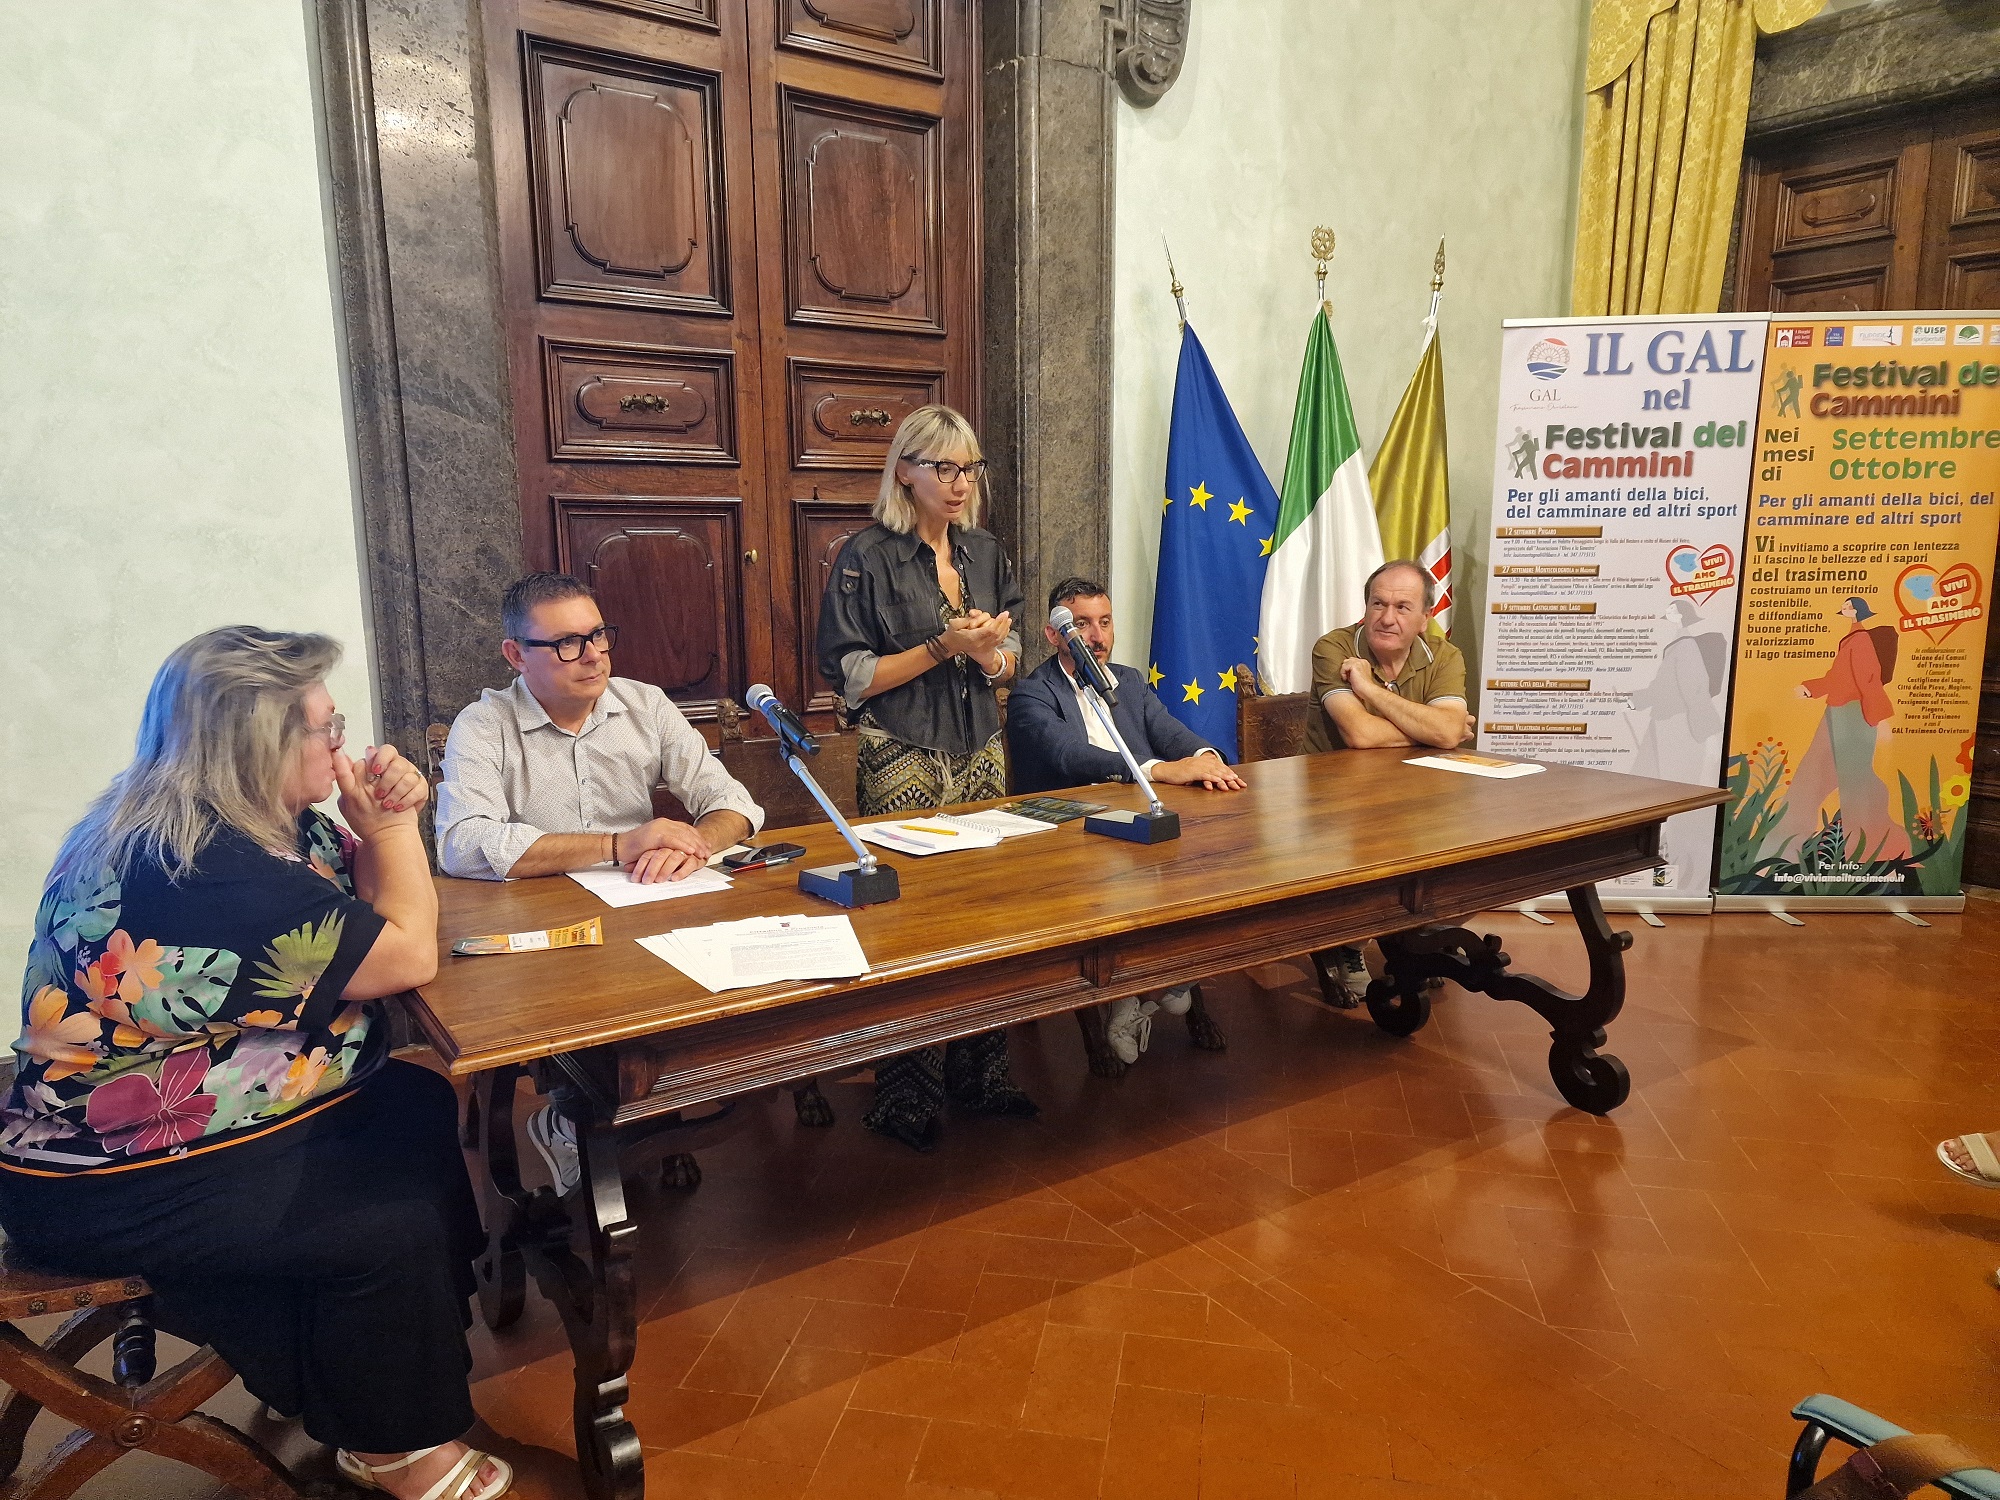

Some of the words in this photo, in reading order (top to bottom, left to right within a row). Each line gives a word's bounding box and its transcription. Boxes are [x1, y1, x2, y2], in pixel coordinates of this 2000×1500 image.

[1583, 332, 1633, 375] IL
[1647, 329, 1754, 375] GAL
[1813, 360, 1948, 388] Festival
[1958, 360, 2000, 386] de
[1530, 389, 1561, 401] GAL
[1642, 379, 1690, 410] nel
[1810, 389, 1961, 418] Cammini
[1545, 422, 1682, 450] Festival
[1694, 420, 1747, 447] dei
[1764, 427, 1799, 443] Nei
[1832, 427, 2000, 450] Settembre
[1763, 447, 1815, 462] mesi
[1543, 451, 1694, 479] Cammini
[1829, 458, 1956, 480] Ottobre
[1761, 466, 1781, 481] di
[1508, 489, 1533, 502] Per
[1539, 488, 1559, 505] gli
[1565, 488, 1621, 502] amanti
[1627, 488, 1666, 501] della
[1673, 487, 1709, 501] bici,
[1759, 494, 1786, 507] Per
[1792, 494, 1813, 510] gli
[1819, 493, 1875, 507] amanti
[1882, 492, 1922, 506] della
[1929, 492, 1963, 507] bici,
[1970, 491, 1994, 505] del
[1506, 505, 1530, 518] del
[1537, 505, 1626, 518] camminare
[1633, 504, 1650, 517] ed
[1657, 503, 1690, 517] altri
[1697, 504, 1737, 519] sport
[1757, 513, 1849, 526] camminare
[1856, 512, 1874, 525] ed
[1881, 512, 1913, 525] altri
[1920, 512, 1961, 527] sport
[1755, 536, 1775, 553] Vi
[1780, 543, 1829, 552] invitiamo
[1833, 544, 1839, 552] a
[1843, 542, 1886, 553] scoprire
[1890, 543, 1909, 551] con
[1914, 542, 1959, 550] lentezza
[1704, 556, 1723, 567] VIVI
[1753, 555, 1761, 564] il
[1765, 555, 1805, 564] fascino
[1809, 555, 1818, 564] le
[1822, 554, 1866, 563] bellezze
[1870, 554, 1882, 563] ed
[1886, 554, 1890, 563] i
[1893, 554, 1928, 564] sapori
[1694, 571, 1716, 580] AMO
[1752, 568, 1779, 582] del
[1785, 568, 1868, 581] trasimeno
[1674, 585, 1682, 594] IL
[1683, 578, 1733, 593] TRASIMENO
[1750, 586, 1812, 595] costruiamo
[1815, 586, 1828, 594] un
[1832, 585, 1878, 594] territorio
[1943, 579, 1968, 593] VIVI
[1930, 598, 1959, 609] AMO
[1749, 612, 1754, 620] e
[1759, 611, 1823, 620] diffondiamo
[1903, 618, 1914, 628] IL
[1916, 607, 1981, 626] TRASIMENO
[1748, 624, 1782, 634] buone
[1746, 637, 1814, 646] valorizziamo
[1745, 650, 1753, 659] il
[1756, 650, 1780, 661] lago
[1783, 649, 1835, 659] trasimeno
[1819, 862, 1835, 870] Per
[1839, 861, 1862, 870] Info:
[1774, 873, 1905, 883] info@viviamoiltrasimeno.it
